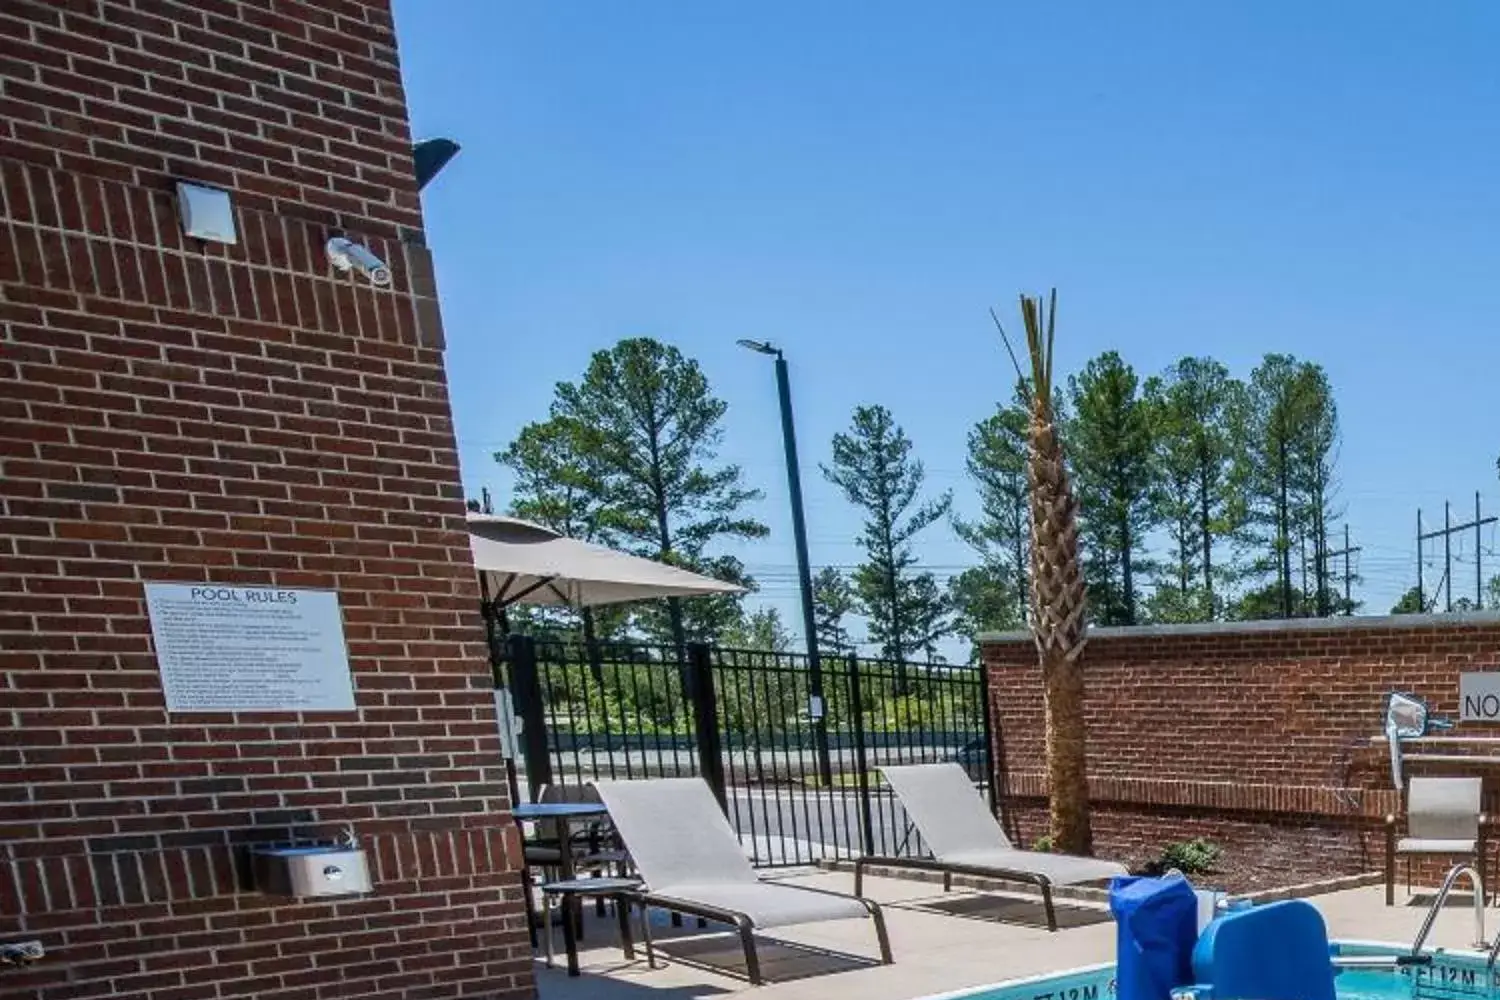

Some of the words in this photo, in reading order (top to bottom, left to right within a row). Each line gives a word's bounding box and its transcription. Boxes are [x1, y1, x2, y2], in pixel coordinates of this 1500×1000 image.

[191, 587, 240, 601] POOL
[245, 589, 298, 605] RULES
[1465, 694, 1500, 718] NO
